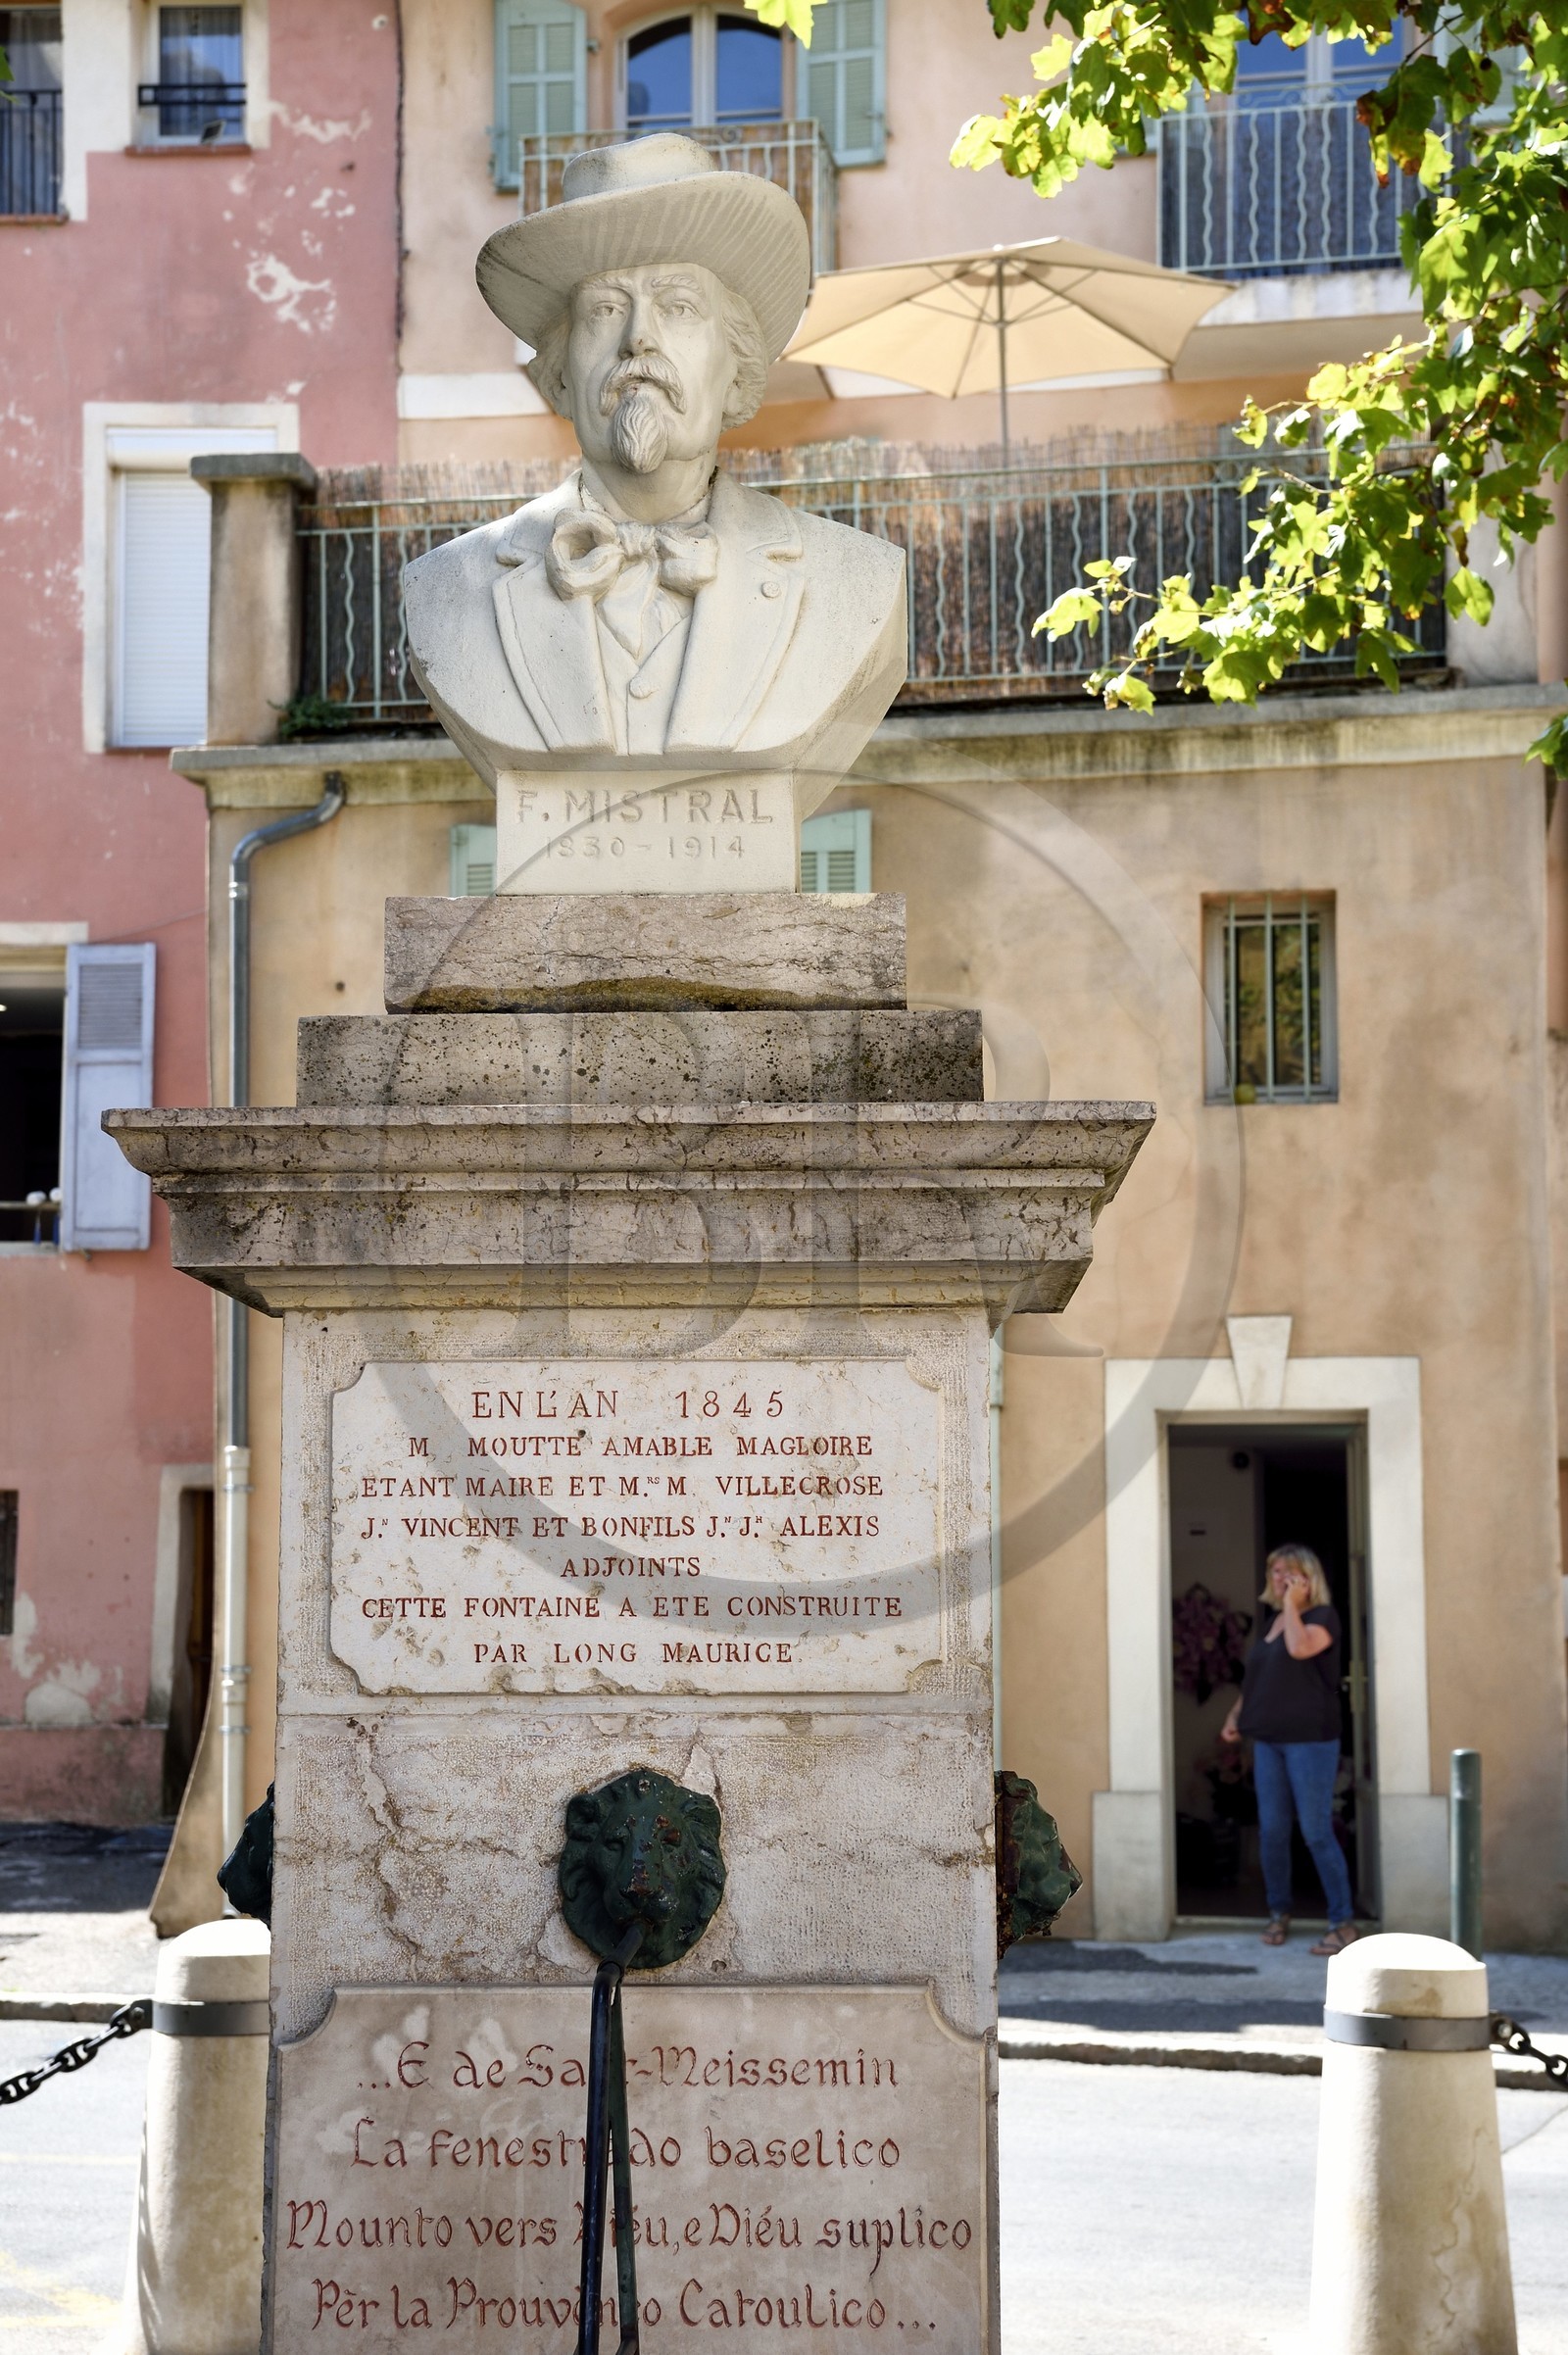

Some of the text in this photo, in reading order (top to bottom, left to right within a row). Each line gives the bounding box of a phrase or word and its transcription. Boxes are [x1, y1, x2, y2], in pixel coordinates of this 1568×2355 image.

[515, 787, 774, 825] F. MISTRAL
[470, 1390, 524, 1419] EN
[674, 1390, 785, 1419] 1845
[466, 1435, 582, 1457] MOUTTE
[603, 1435, 713, 1457] AMABLE
[736, 1435, 873, 1457] MAGLOIRE
[361, 1476, 456, 1498] ETANT
[465, 1476, 555, 1497] MAIRE
[568, 1475, 606, 1497] ET
[714, 1475, 884, 1497] VILLECROSE
[401, 1516, 519, 1539] VINCENT
[532, 1516, 569, 1538] ET
[581, 1515, 696, 1539] BONFILS
[779, 1515, 880, 1538] ALEXIS
[560, 1556, 702, 1578] ADJOINTS
[362, 1595, 903, 1619] CETTE FONTAINE A ETE CONSTRUITE
[473, 1644, 528, 1664] PAR
[554, 1643, 637, 1664] LONG
[453, 2050, 507, 2089] de
[516, 2043, 900, 2088] Sa-Meissemin
[350, 2116, 408, 2168] La
[705, 2126, 901, 2169] baselico
[286, 2199, 454, 2249] Mounto
[465, 2216, 558, 2249] vers
[815, 2205, 973, 2278] suplico
[390, 2284, 433, 2330] la
[446, 2277, 662, 2330] Prouvno
